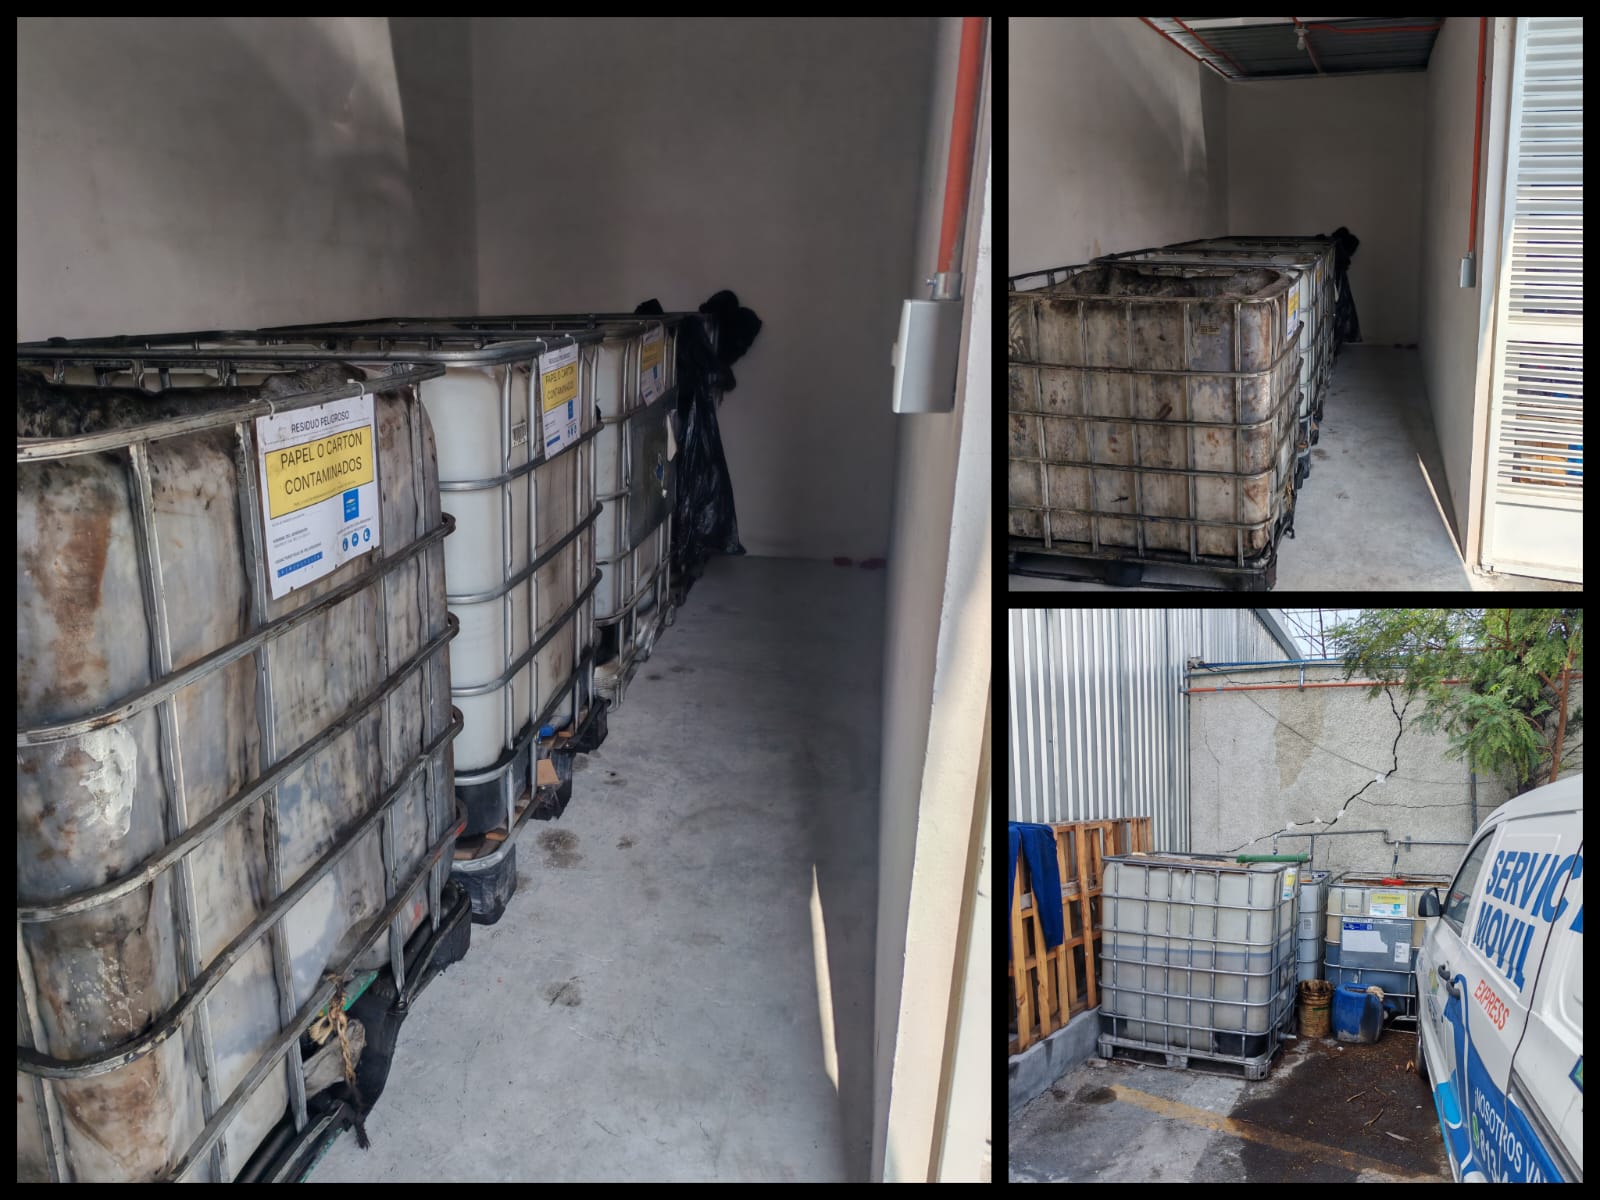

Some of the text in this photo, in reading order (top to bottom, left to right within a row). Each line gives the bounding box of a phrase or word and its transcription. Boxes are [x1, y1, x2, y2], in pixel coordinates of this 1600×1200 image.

[291, 417, 320, 434] RESIDUO
[320, 410, 350, 427] PELIGROSO
[280, 447, 315, 470] PAPEL
[317, 443, 325, 458] O
[284, 456, 363, 496] CONTAMINADOS
[1485, 850, 1583, 934] SERVIC
[1472, 901, 1535, 993] MOVIL
[1474, 979, 1510, 1031] EXPRESS
